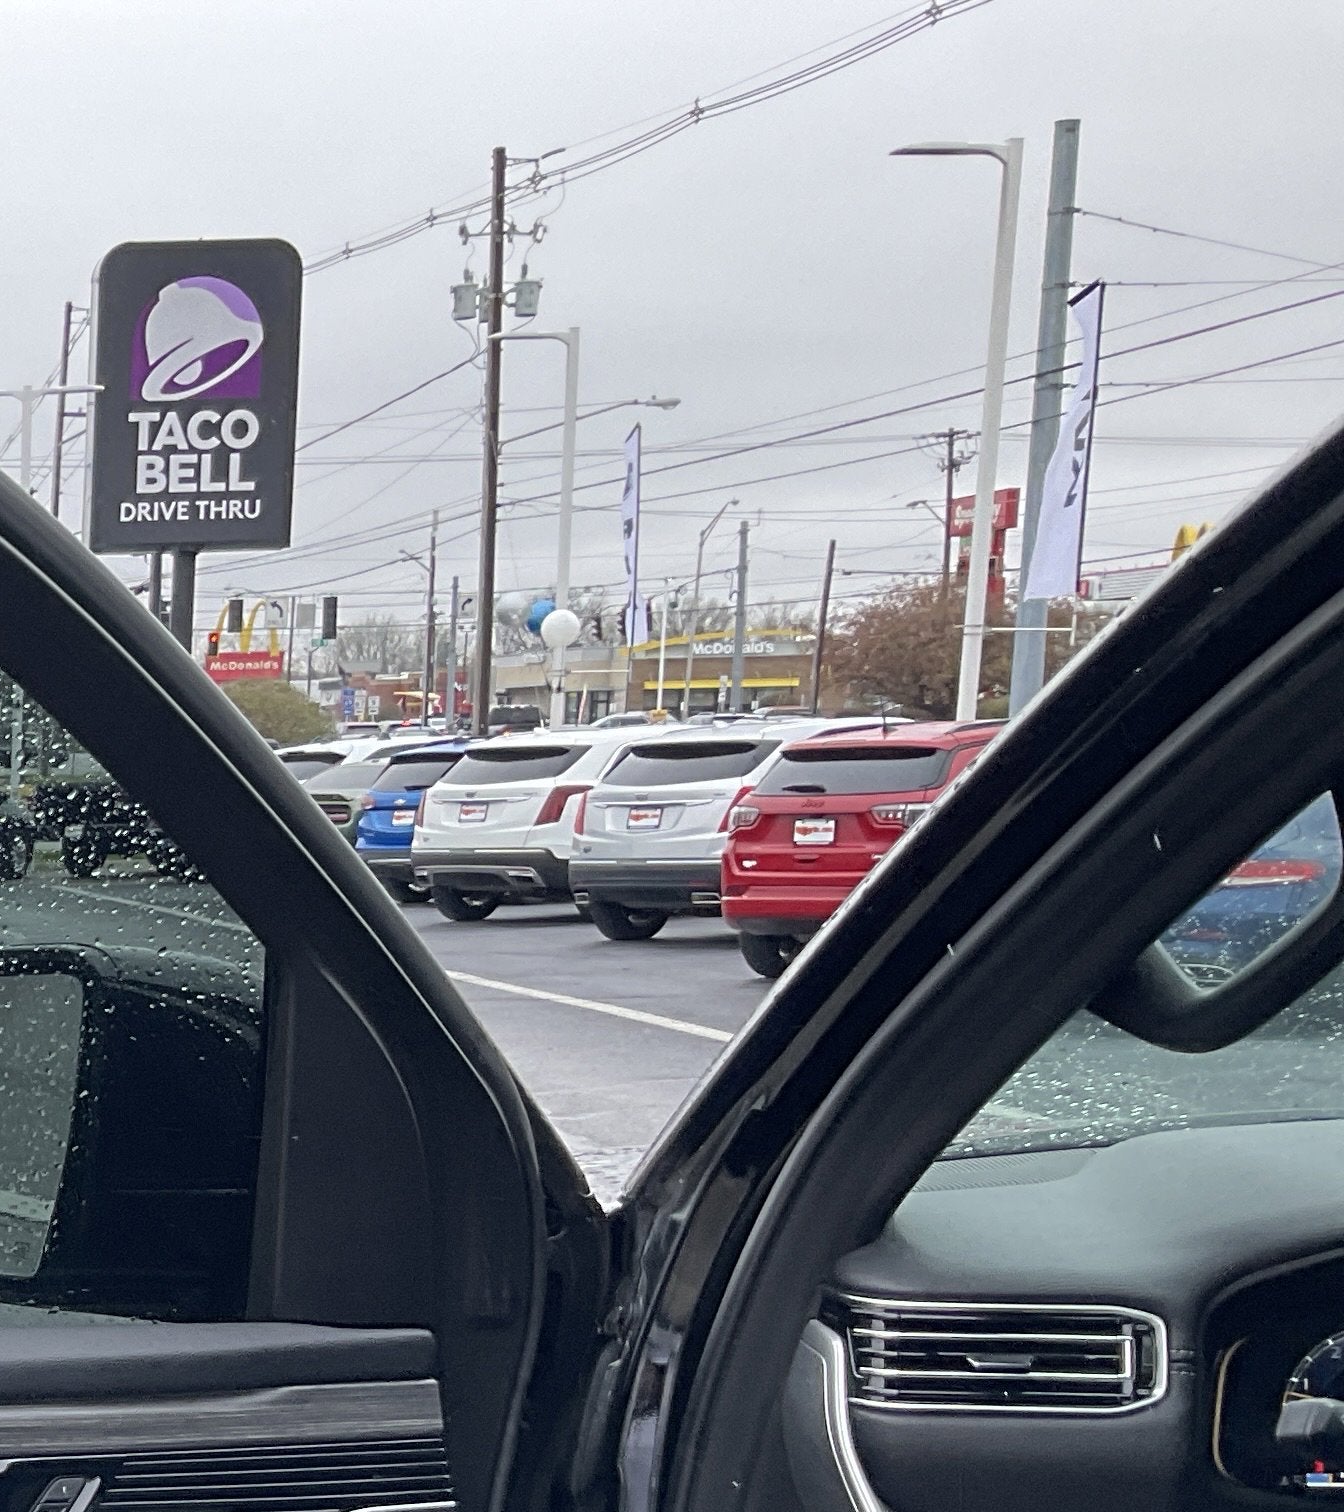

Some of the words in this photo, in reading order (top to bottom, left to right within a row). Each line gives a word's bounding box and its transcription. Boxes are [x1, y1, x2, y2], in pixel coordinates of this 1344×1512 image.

[127, 409, 260, 451] TACO
[135, 452, 256, 494] BELL
[119, 501, 190, 522] DRIVE
[195, 499, 262, 520] THRU
[693, 640, 775, 655] McDoald's
[209, 660, 280, 671] McDonald's
